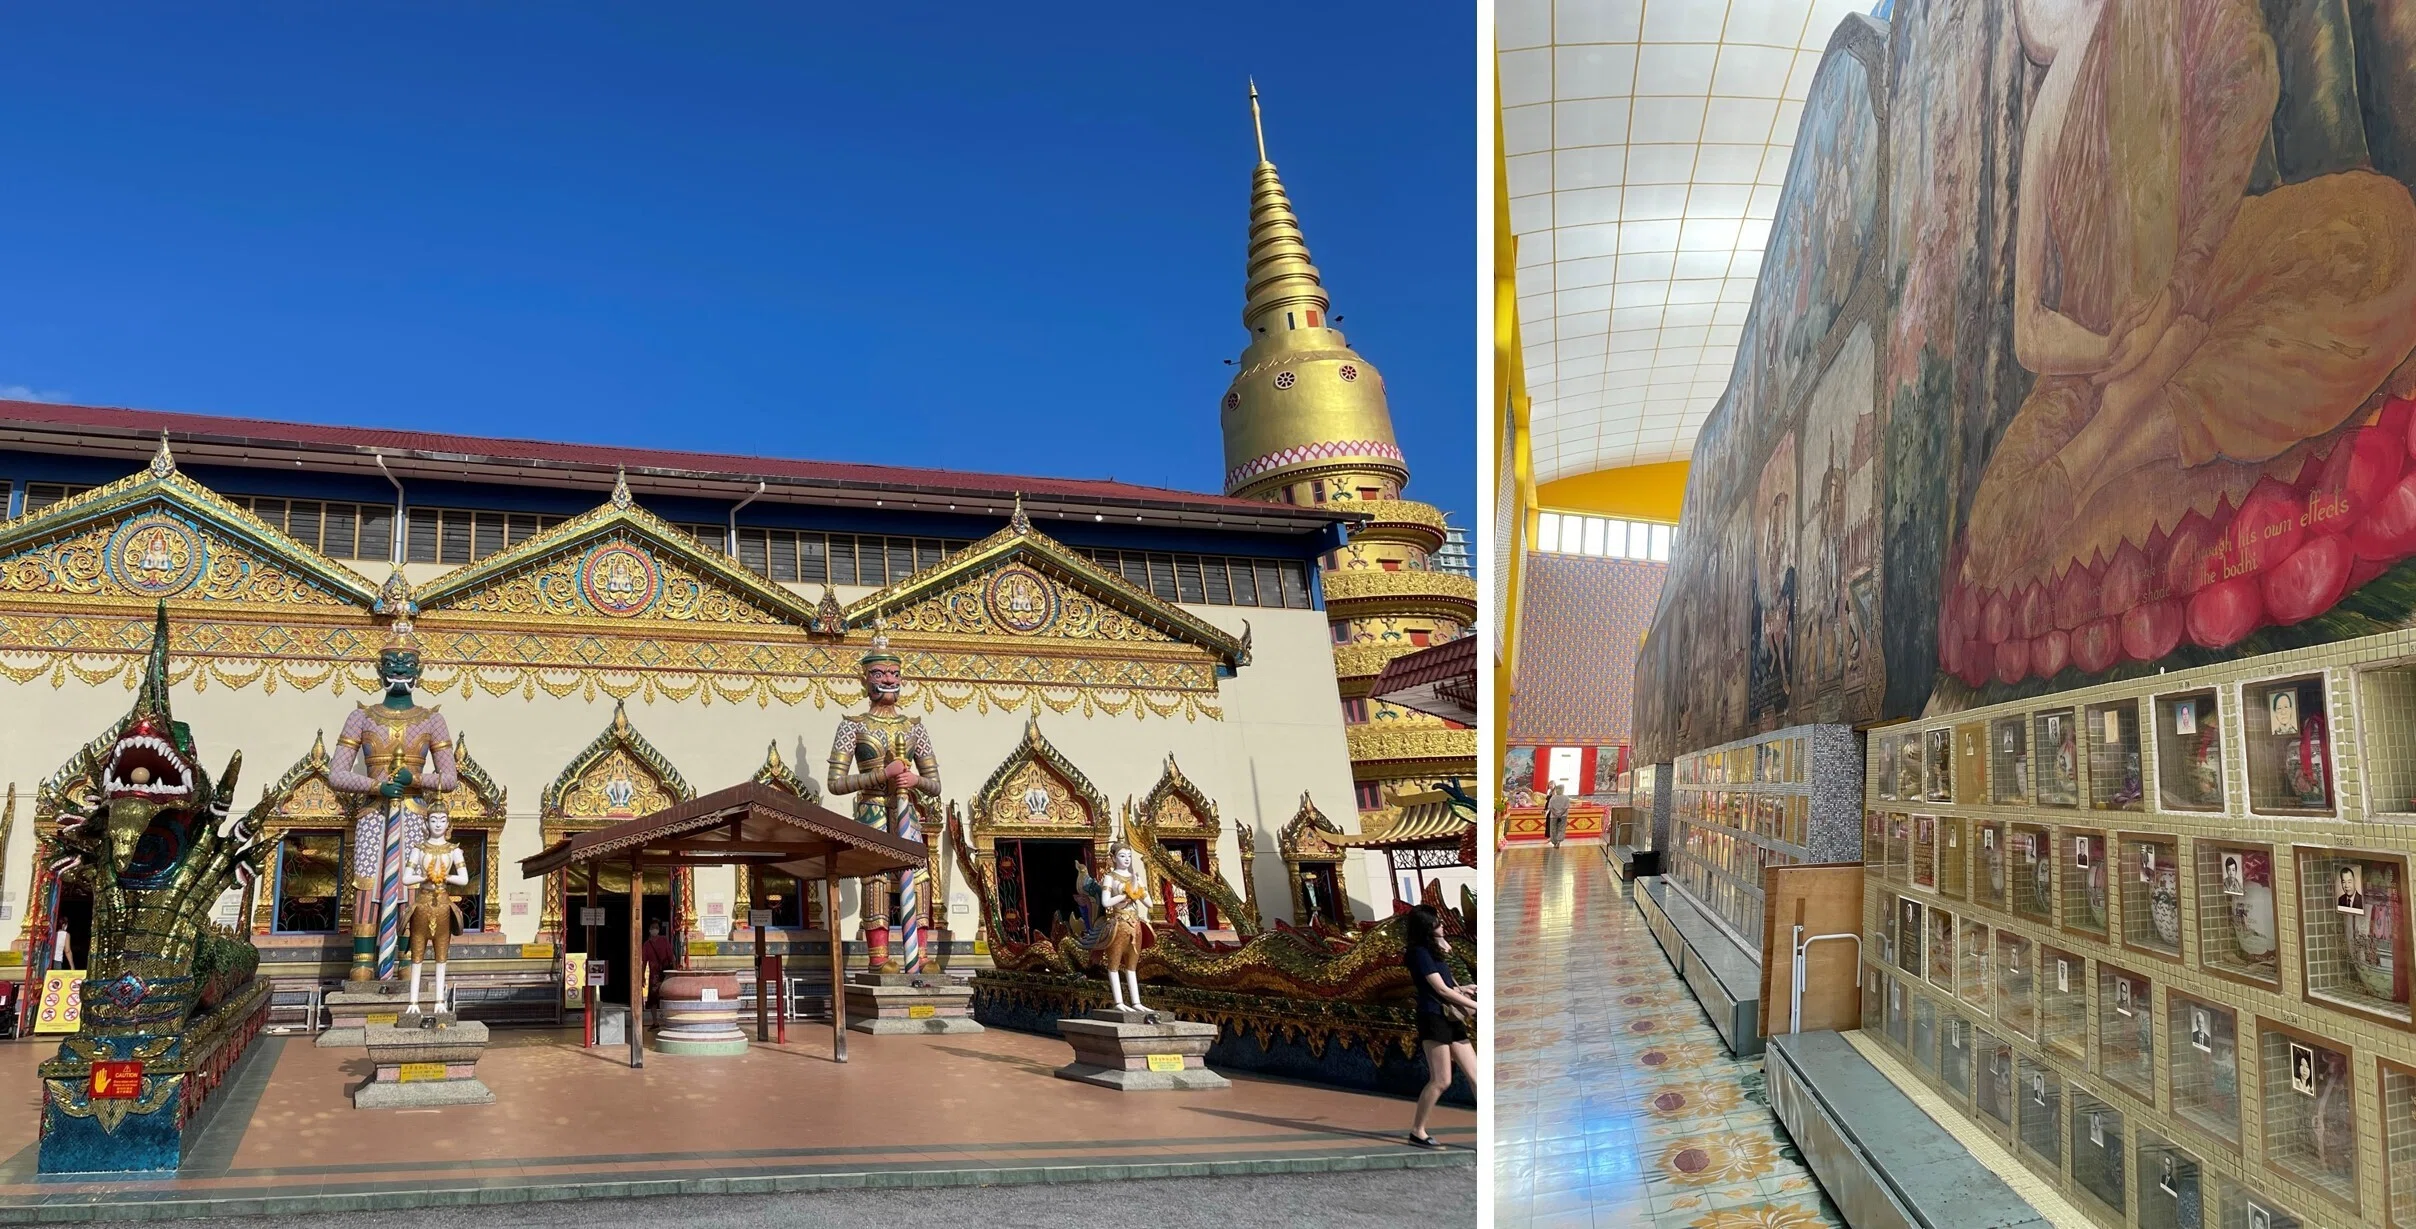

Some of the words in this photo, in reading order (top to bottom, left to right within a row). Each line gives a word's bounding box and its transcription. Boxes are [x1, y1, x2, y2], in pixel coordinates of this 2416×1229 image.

[2238, 520, 2257, 549] his
[2264, 517, 2292, 539] own
[2142, 579, 2171, 604] shade
[2223, 547, 2257, 580] bodhi
